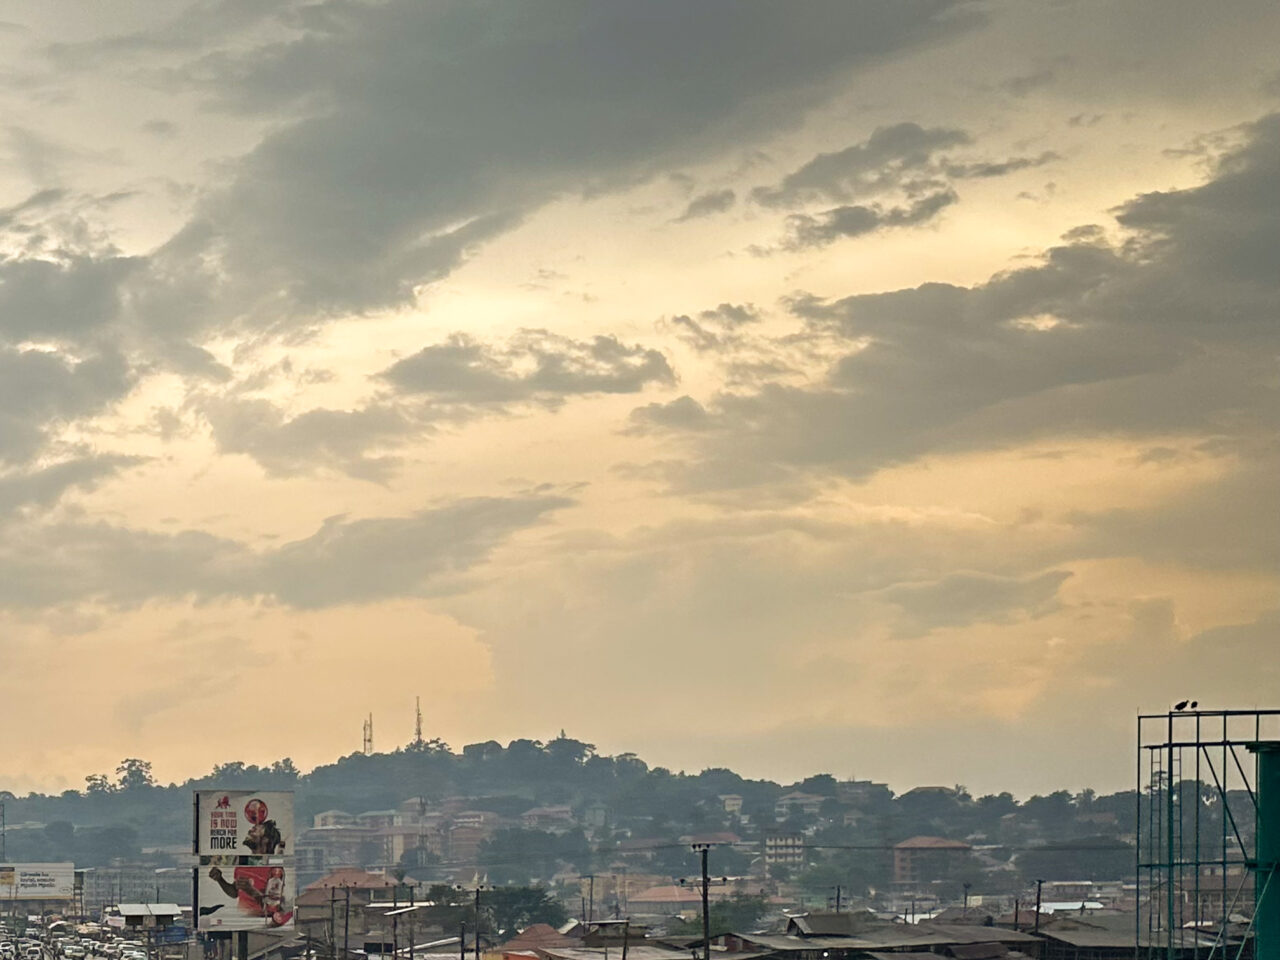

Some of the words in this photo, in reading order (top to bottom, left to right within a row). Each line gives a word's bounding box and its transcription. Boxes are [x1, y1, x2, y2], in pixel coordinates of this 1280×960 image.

[211, 819, 218, 828] IS
[221, 819, 237, 828] NOW
[210, 837, 237, 849] MORE
